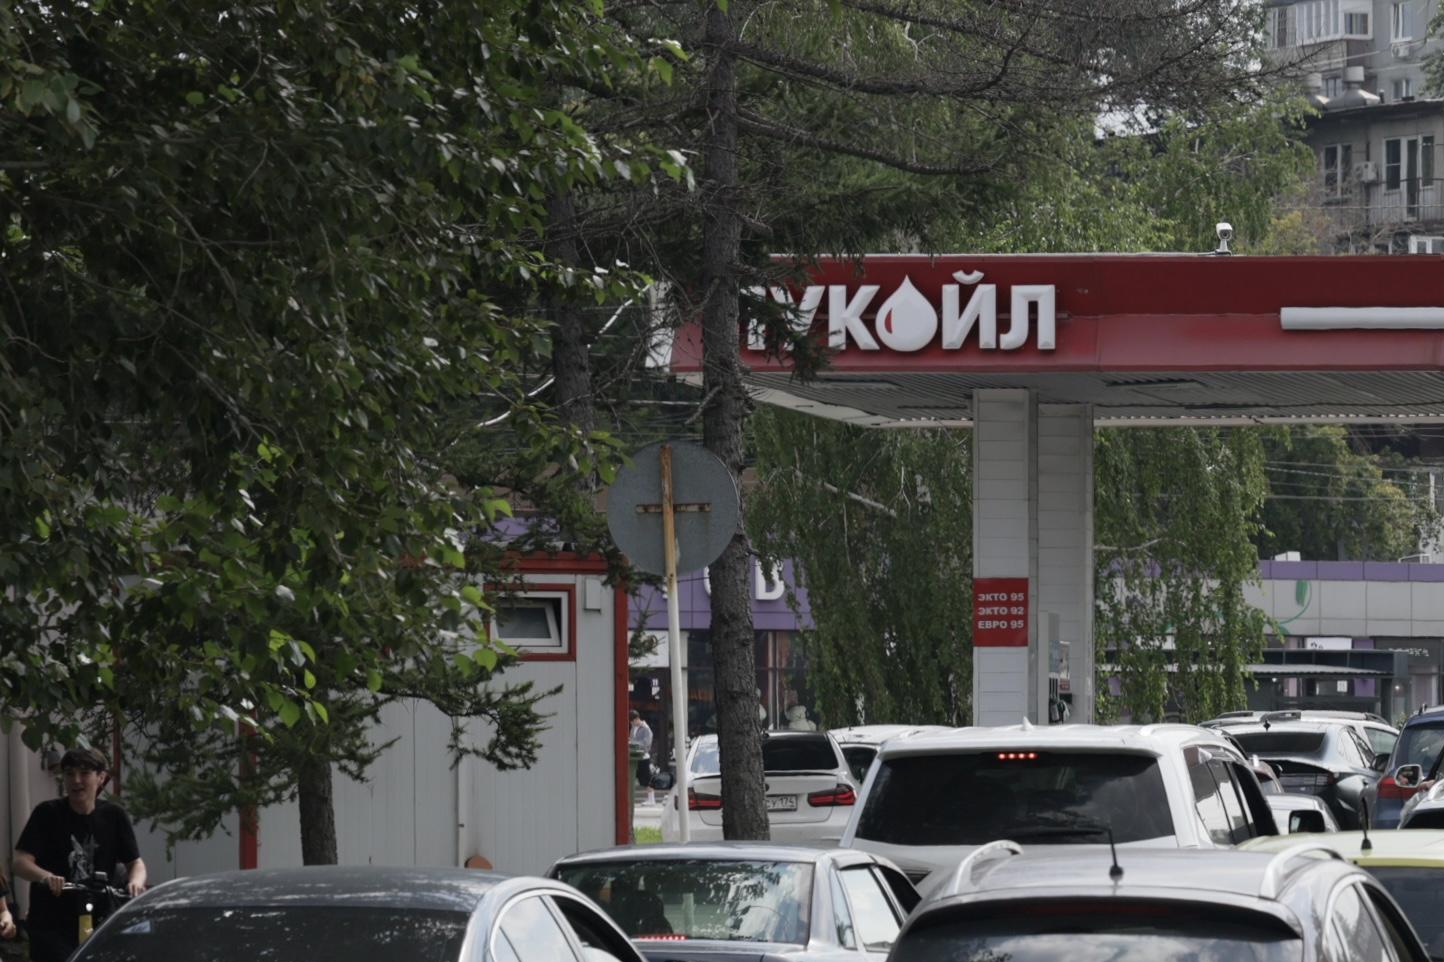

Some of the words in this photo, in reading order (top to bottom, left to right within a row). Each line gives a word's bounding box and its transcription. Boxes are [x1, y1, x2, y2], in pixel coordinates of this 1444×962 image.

[978, 593, 1007, 601] ЭКТО
[1010, 593, 1024, 601] 95
[978, 607, 1007, 615] ЭКТО
[1010, 607, 1024, 615] 92
[978, 621, 1007, 629] ЕВРО
[1010, 621, 1024, 629] 95
